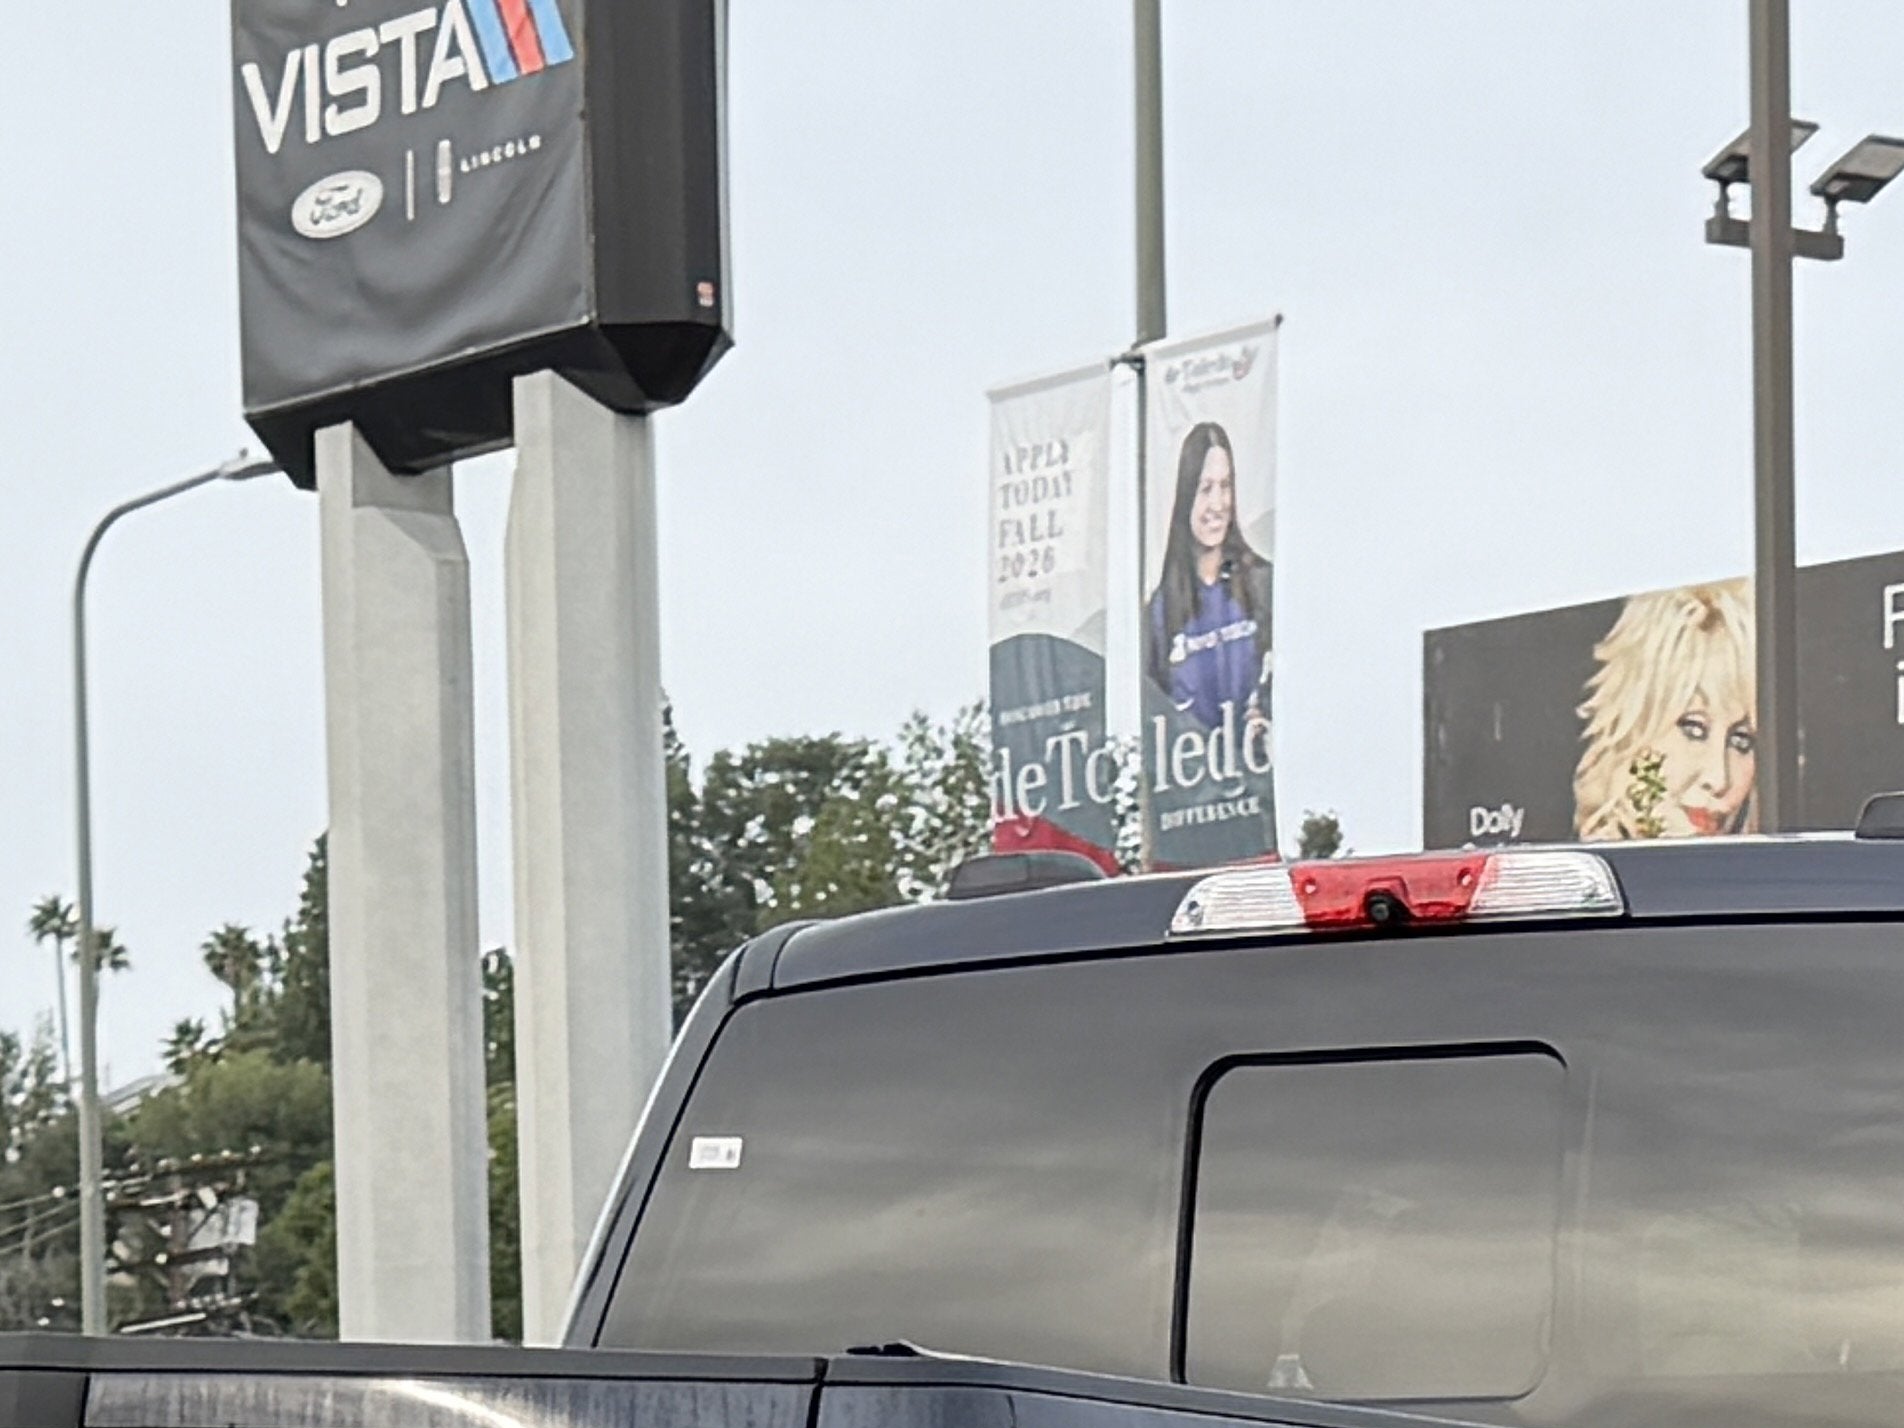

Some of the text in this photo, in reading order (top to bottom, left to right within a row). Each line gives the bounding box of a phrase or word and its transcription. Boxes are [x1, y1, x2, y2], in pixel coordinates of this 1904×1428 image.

[241, 0, 488, 154] VISTA
[999, 470, 1073, 510] TODAY
[998, 510, 1063, 548] FALL
